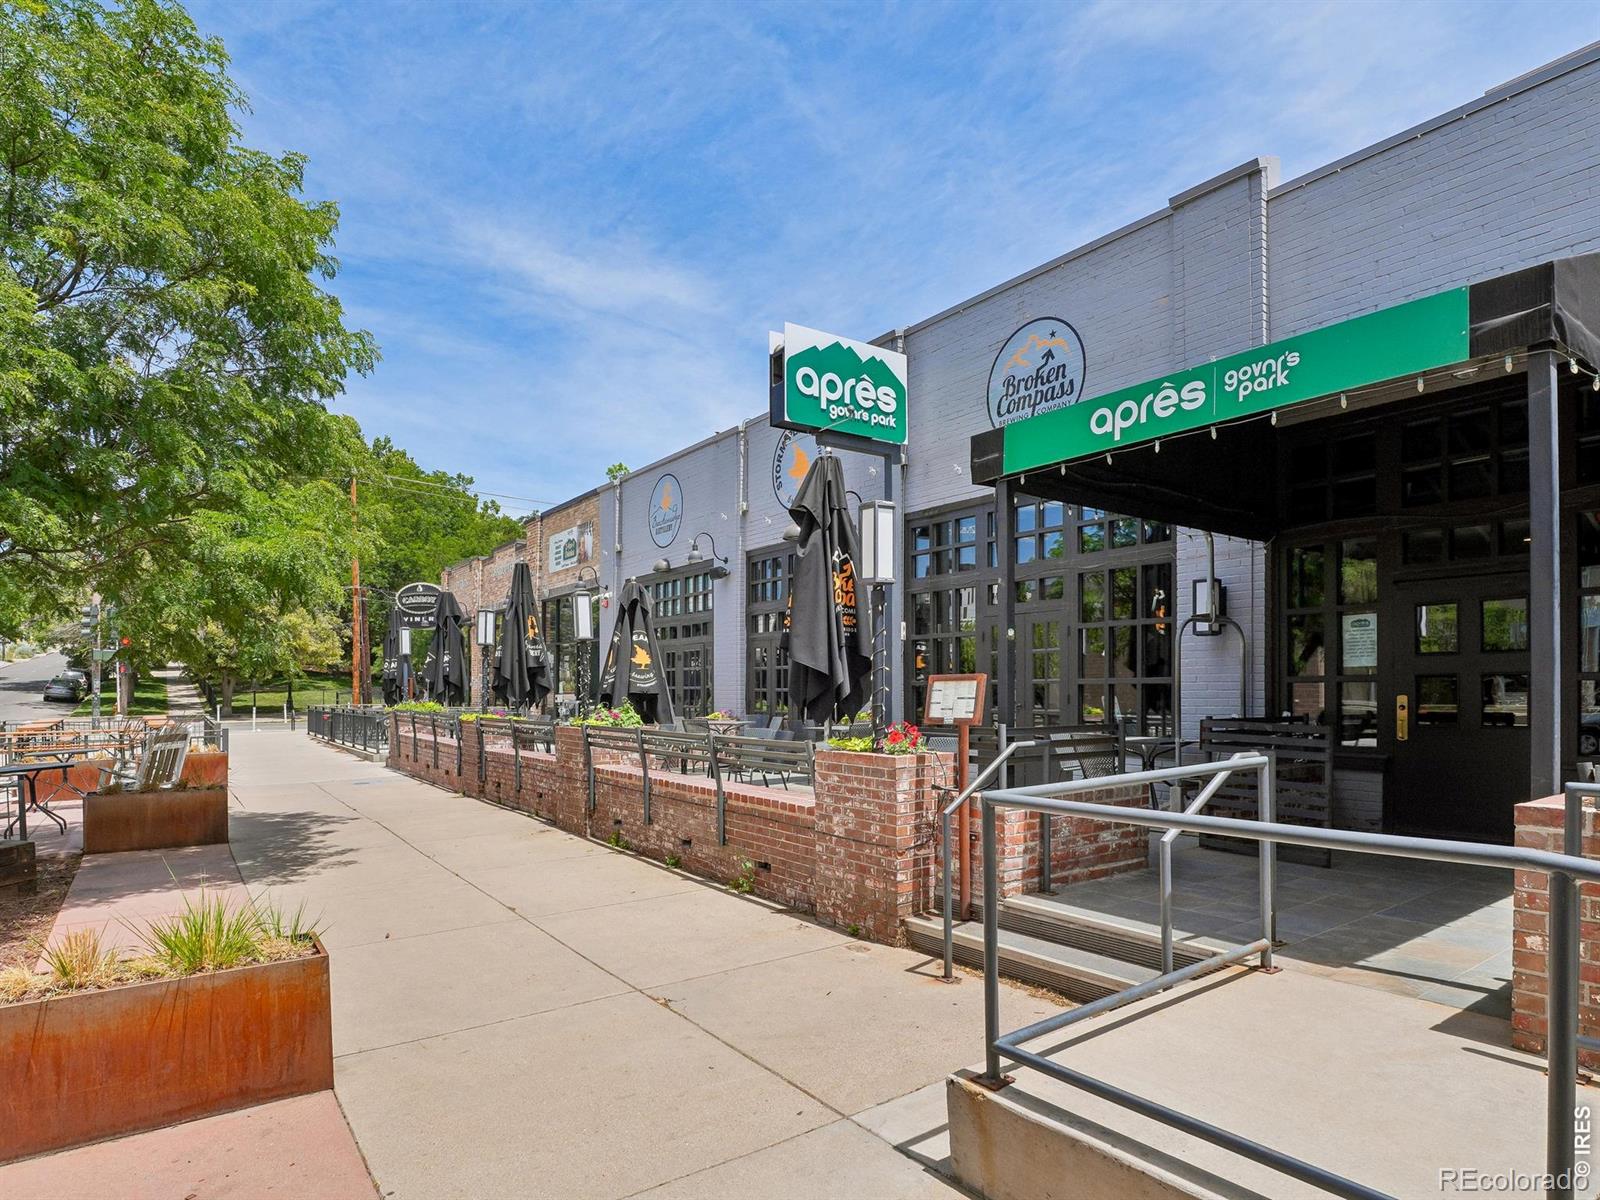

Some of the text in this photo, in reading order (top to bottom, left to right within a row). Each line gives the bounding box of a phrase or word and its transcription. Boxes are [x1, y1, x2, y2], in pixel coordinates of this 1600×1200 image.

[796, 366, 897, 413] après
[1002, 361, 1067, 398] Broken
[1224, 350, 1300, 392] govnr's
[1239, 368, 1290, 402] park
[996, 378, 1074, 417] Compass
[1036, 399, 1071, 416] COMPANY
[1090, 381, 1206, 441] après
[871, 413, 896, 428] park
